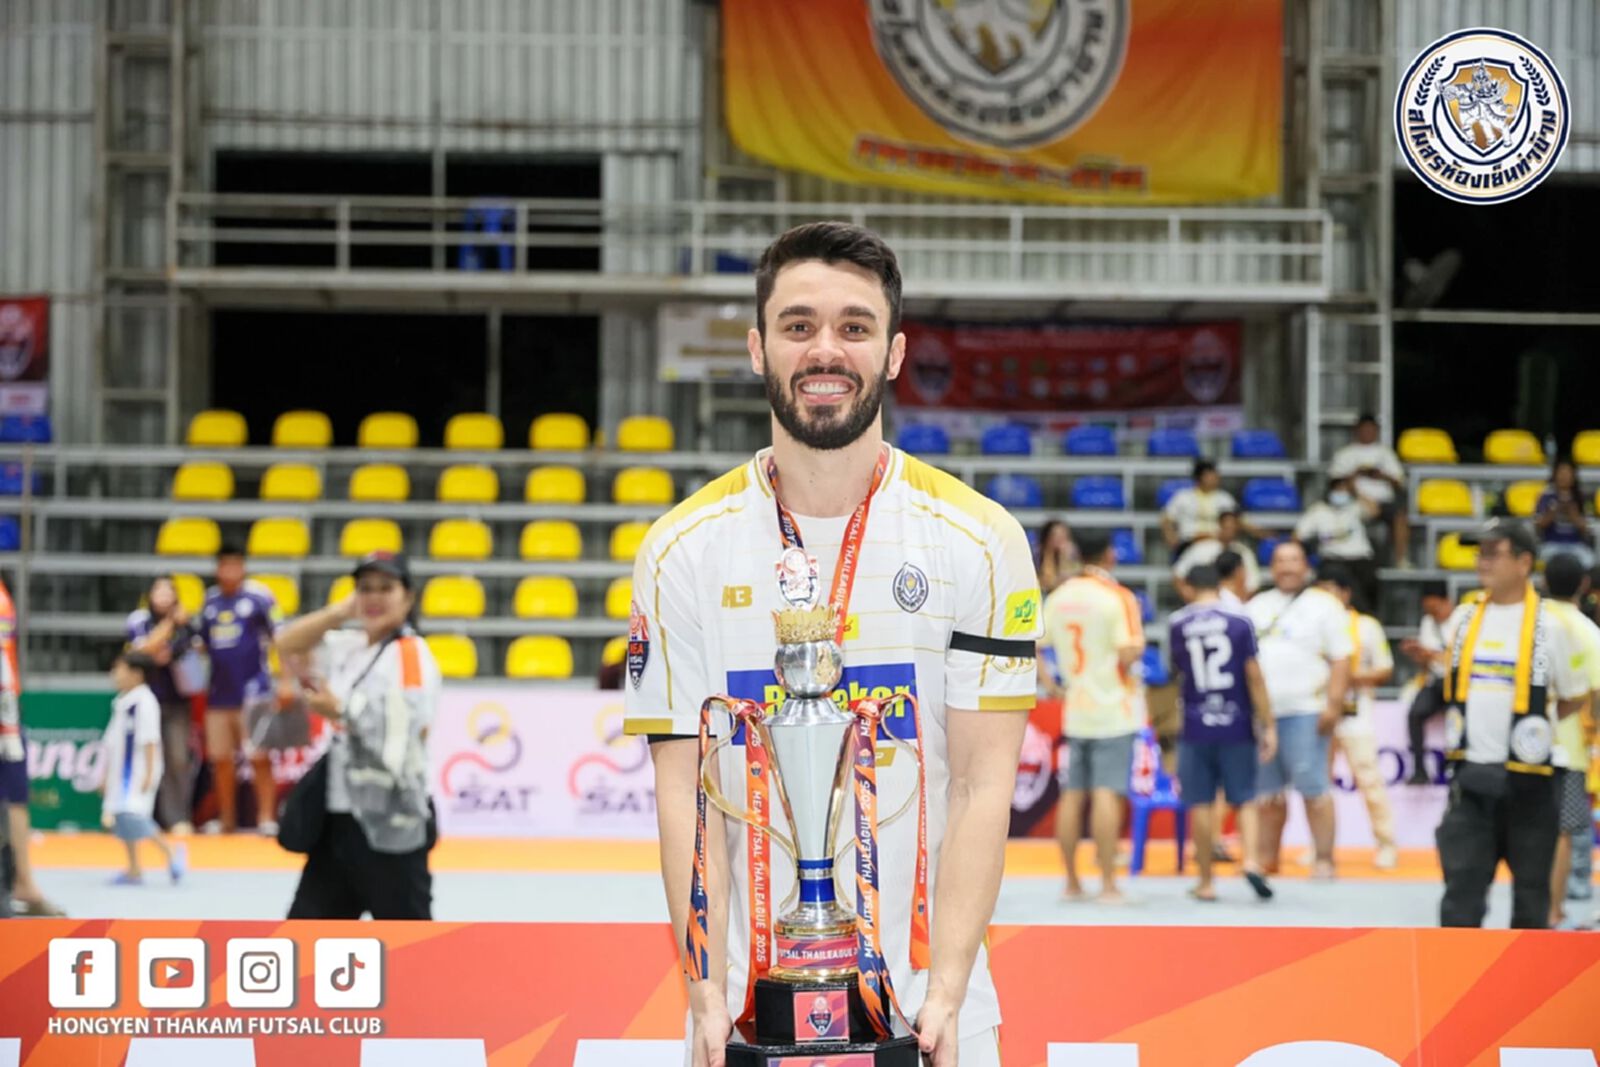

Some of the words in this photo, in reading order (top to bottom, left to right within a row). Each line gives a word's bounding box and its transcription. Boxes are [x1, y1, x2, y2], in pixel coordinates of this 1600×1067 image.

[1066, 623, 1085, 675] 3
[1185, 634, 1234, 693] 12
[764, 682, 910, 718] Baker
[457, 788, 535, 812] SAT
[860, 815, 873, 884] THAILEAGUE
[754, 861, 766, 928] THAILEAGUE
[863, 890, 873, 929] FUTSAL
[755, 934, 766, 963] 2025
[863, 934, 874, 958] MEA
